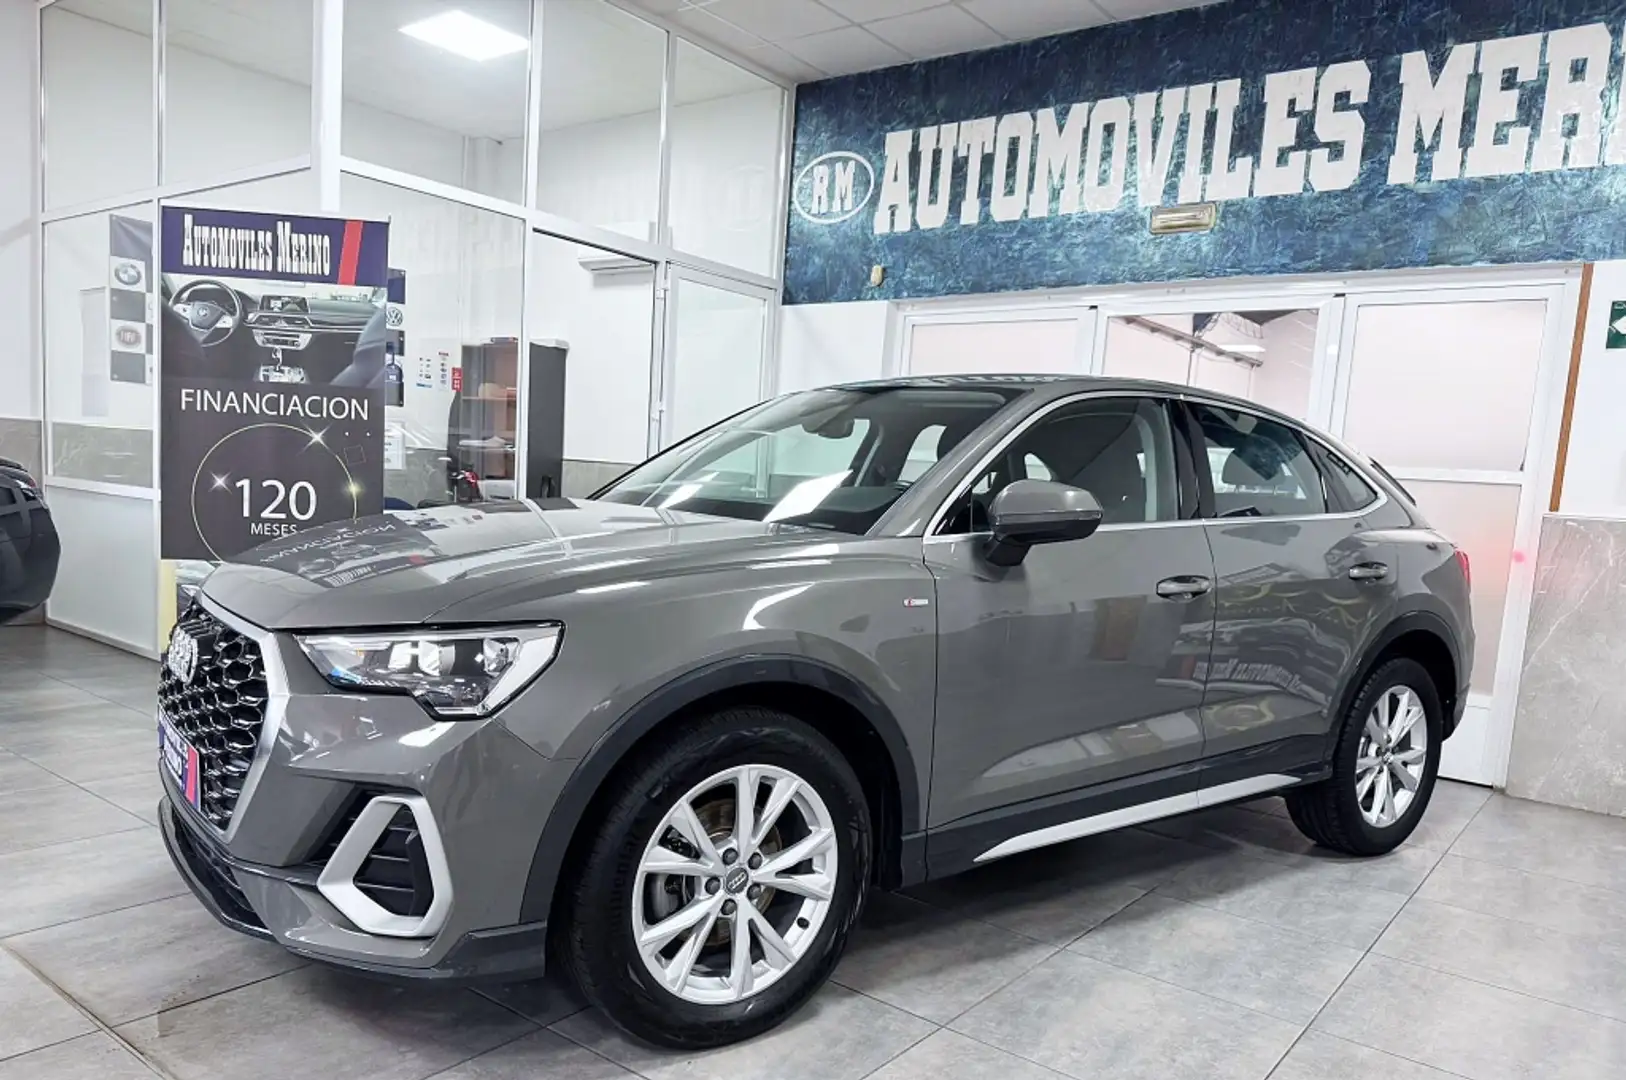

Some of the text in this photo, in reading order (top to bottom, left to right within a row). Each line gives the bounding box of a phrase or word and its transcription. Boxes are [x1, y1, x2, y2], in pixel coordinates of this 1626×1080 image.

[874, 60, 1371, 234] AUTOMOVILES
[183, 213, 331, 276] AUTOMOVILES MERINO
[181, 388, 369, 421] FINANCIACION
[235, 478, 318, 521] 120
[250, 522, 298, 536] MESES
